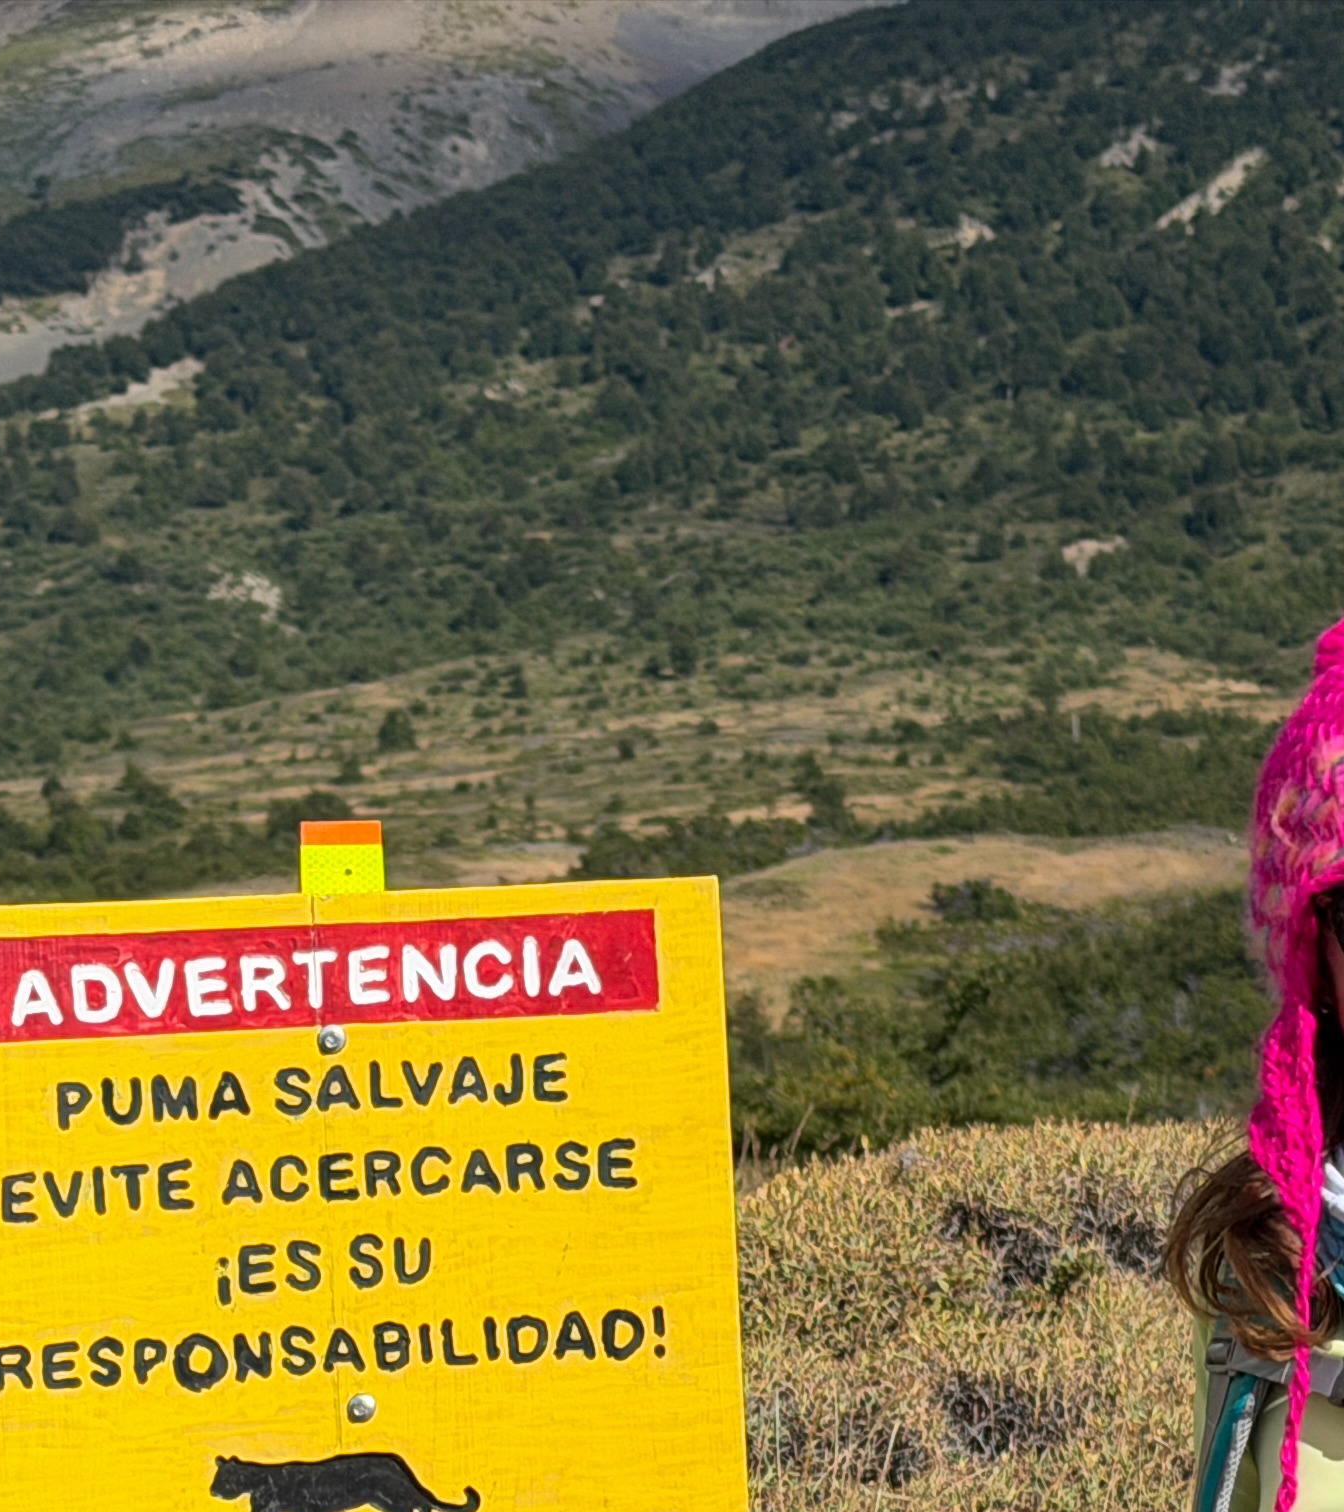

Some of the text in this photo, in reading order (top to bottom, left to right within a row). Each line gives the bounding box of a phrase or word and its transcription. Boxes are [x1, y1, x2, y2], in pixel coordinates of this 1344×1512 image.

[10, 935, 602, 1026] ADVERTENCIA
[57, 1051, 569, 1129] PUMA SALVAJE
[1, 1138, 638, 1223] EVITE ACERCARSE
[216, 1233, 432, 1307] ¡ES SU
